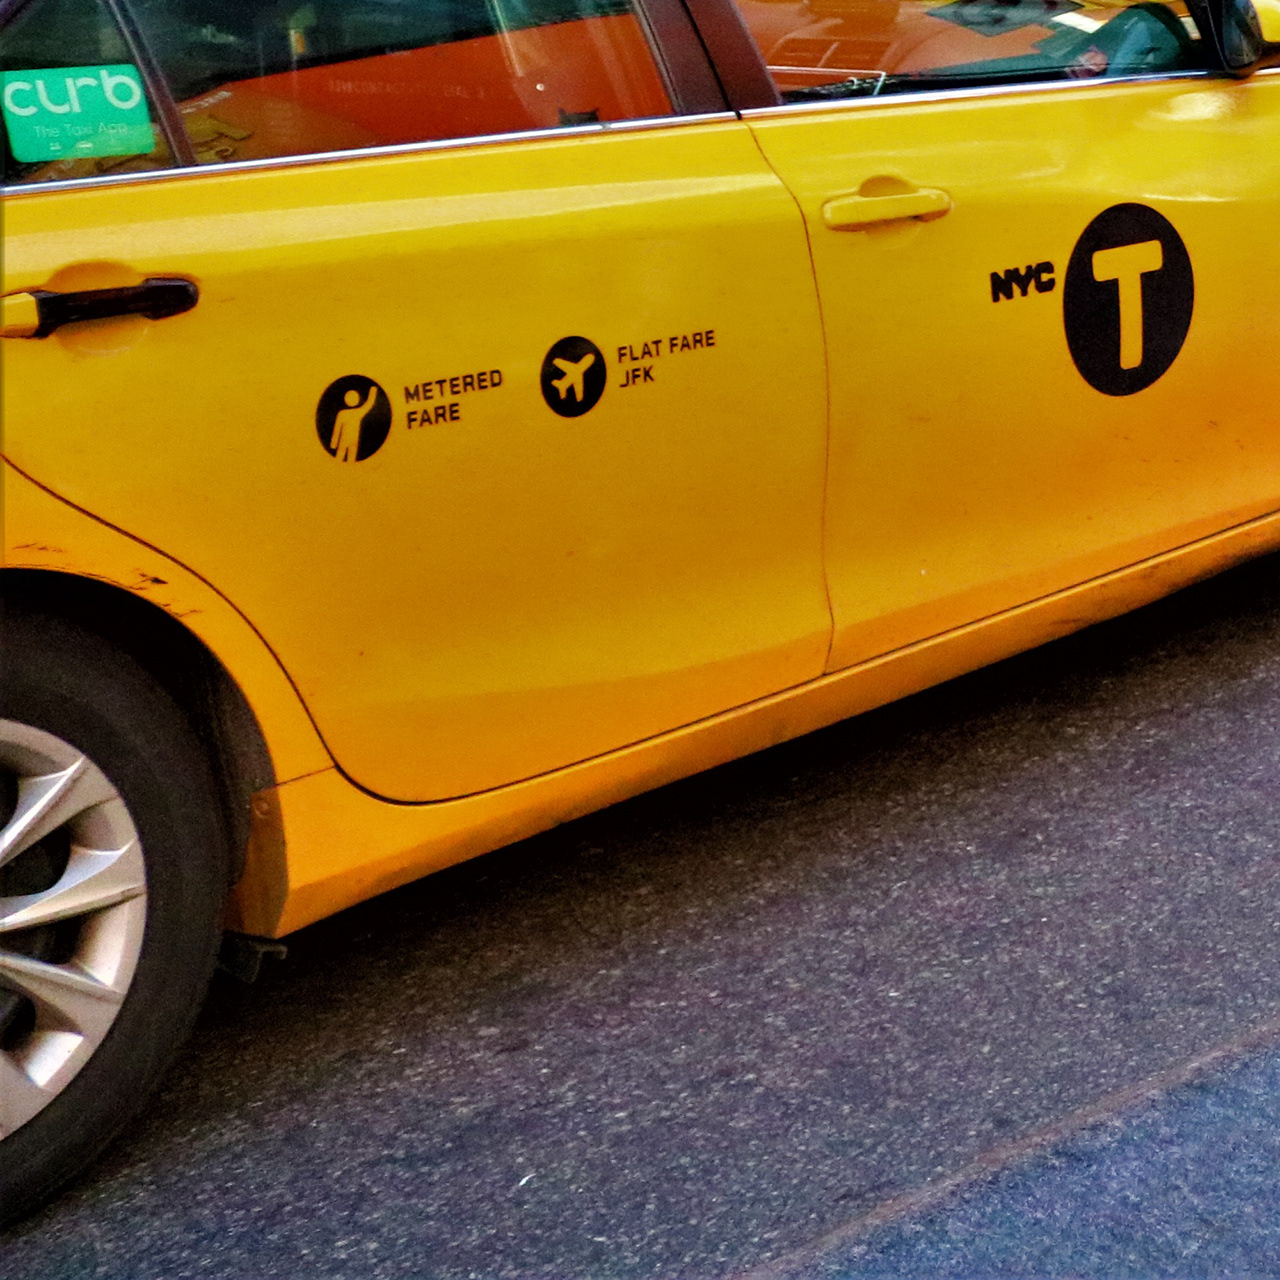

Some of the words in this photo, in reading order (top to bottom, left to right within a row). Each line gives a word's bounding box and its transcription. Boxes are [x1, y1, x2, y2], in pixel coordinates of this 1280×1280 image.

[4, 70, 141, 117] curb
[33, 125, 60, 139] The
[64, 123, 94, 137] Taxi
[98, 122, 129, 136] App
[990, 261, 1056, 303] NYC
[1091, 239, 1164, 371] T
[618, 339, 662, 364] FLAT
[669, 330, 716, 354] FARE
[404, 369, 503, 404] METERED
[619, 365, 655, 388] JFK
[407, 403, 461, 429] FARE
